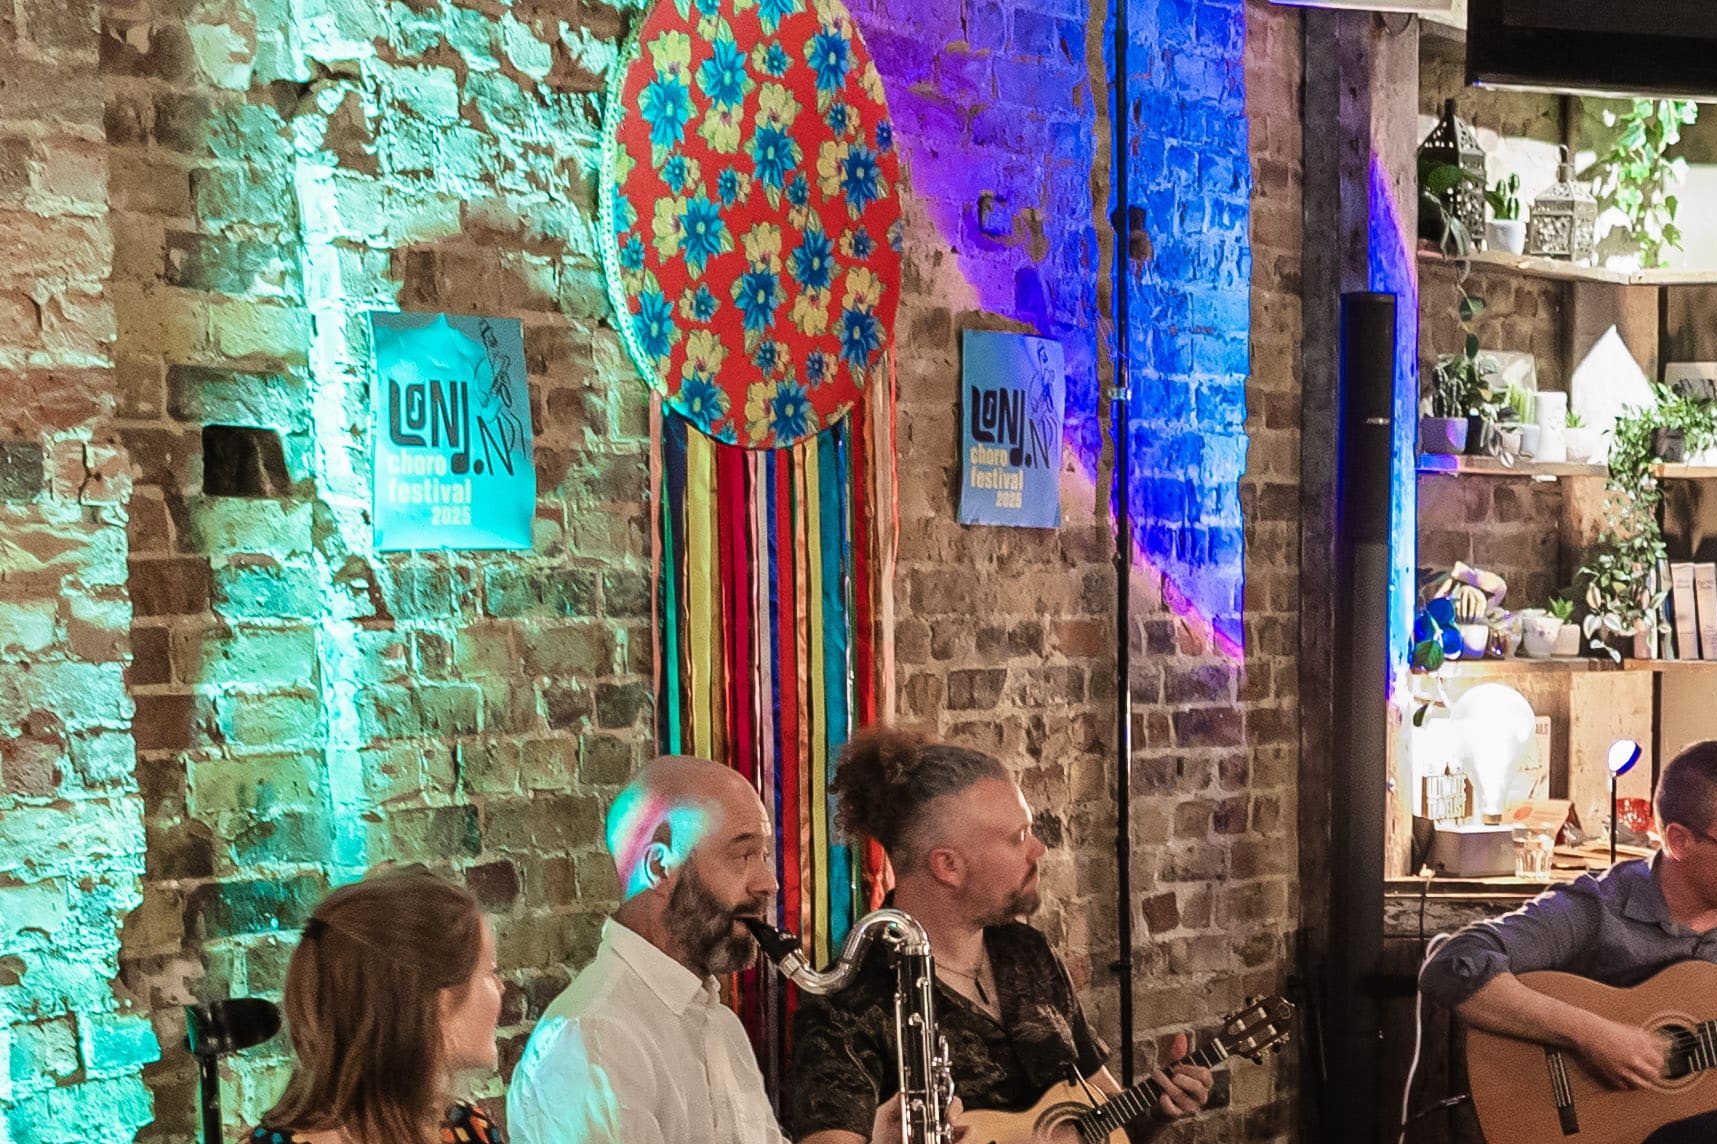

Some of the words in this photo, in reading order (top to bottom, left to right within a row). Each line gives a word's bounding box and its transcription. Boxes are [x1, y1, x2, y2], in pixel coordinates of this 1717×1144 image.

[387, 450, 448, 477] choro
[970, 443, 1008, 467] choro
[970, 467, 1024, 490] festival
[388, 478, 472, 505] festival
[996, 491, 1022, 508] 2025
[431, 506, 472, 526] 2025
